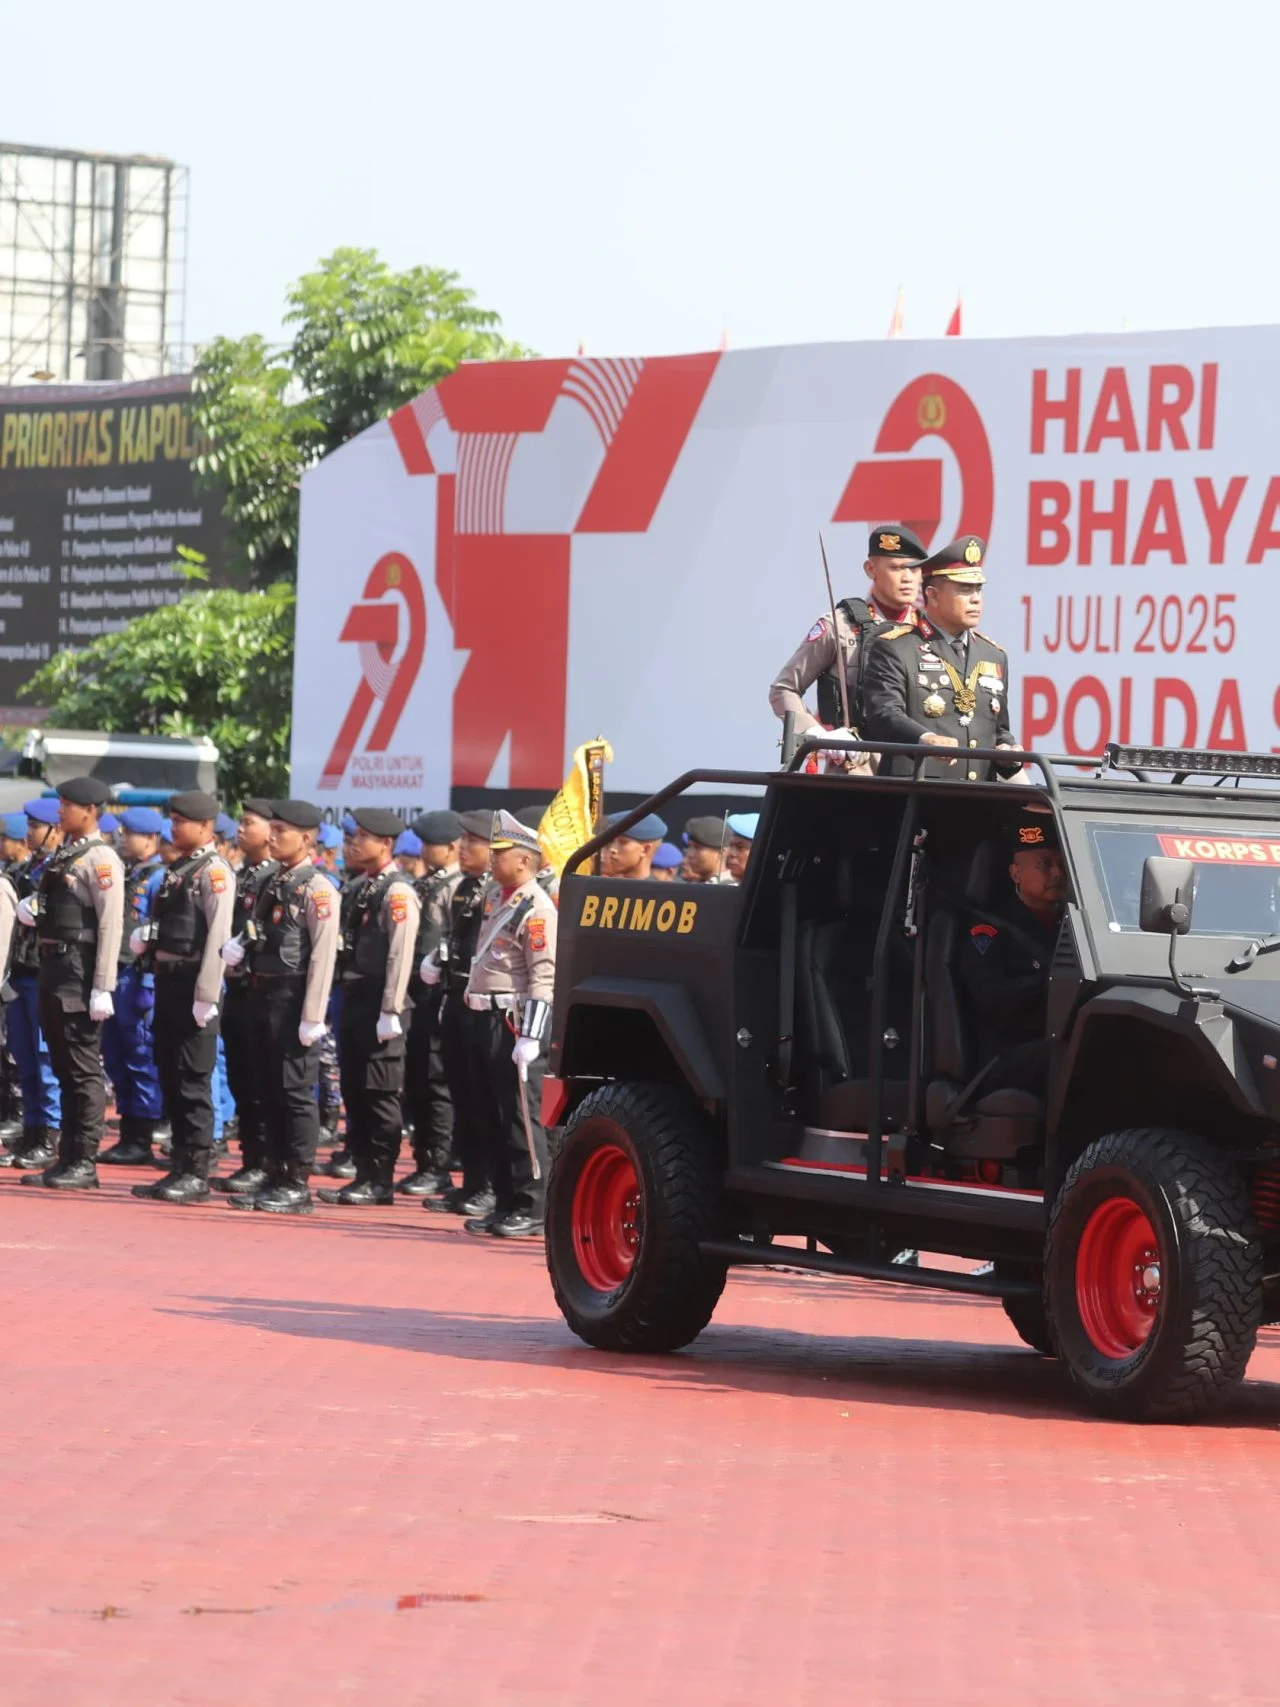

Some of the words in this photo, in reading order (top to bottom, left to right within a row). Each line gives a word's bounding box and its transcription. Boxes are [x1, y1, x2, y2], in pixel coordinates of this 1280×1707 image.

[1, 408, 114, 469] PRIORITAS
[119, 403, 211, 465] KAPOL
[1030, 363, 1218, 454] HARI
[1021, 595, 1032, 653] 1
[1043, 595, 1121, 654] JULI
[1134, 594, 1236, 654] 2025
[1173, 839, 1268, 862] KORPS
[580, 895, 698, 934] BRIMOB
